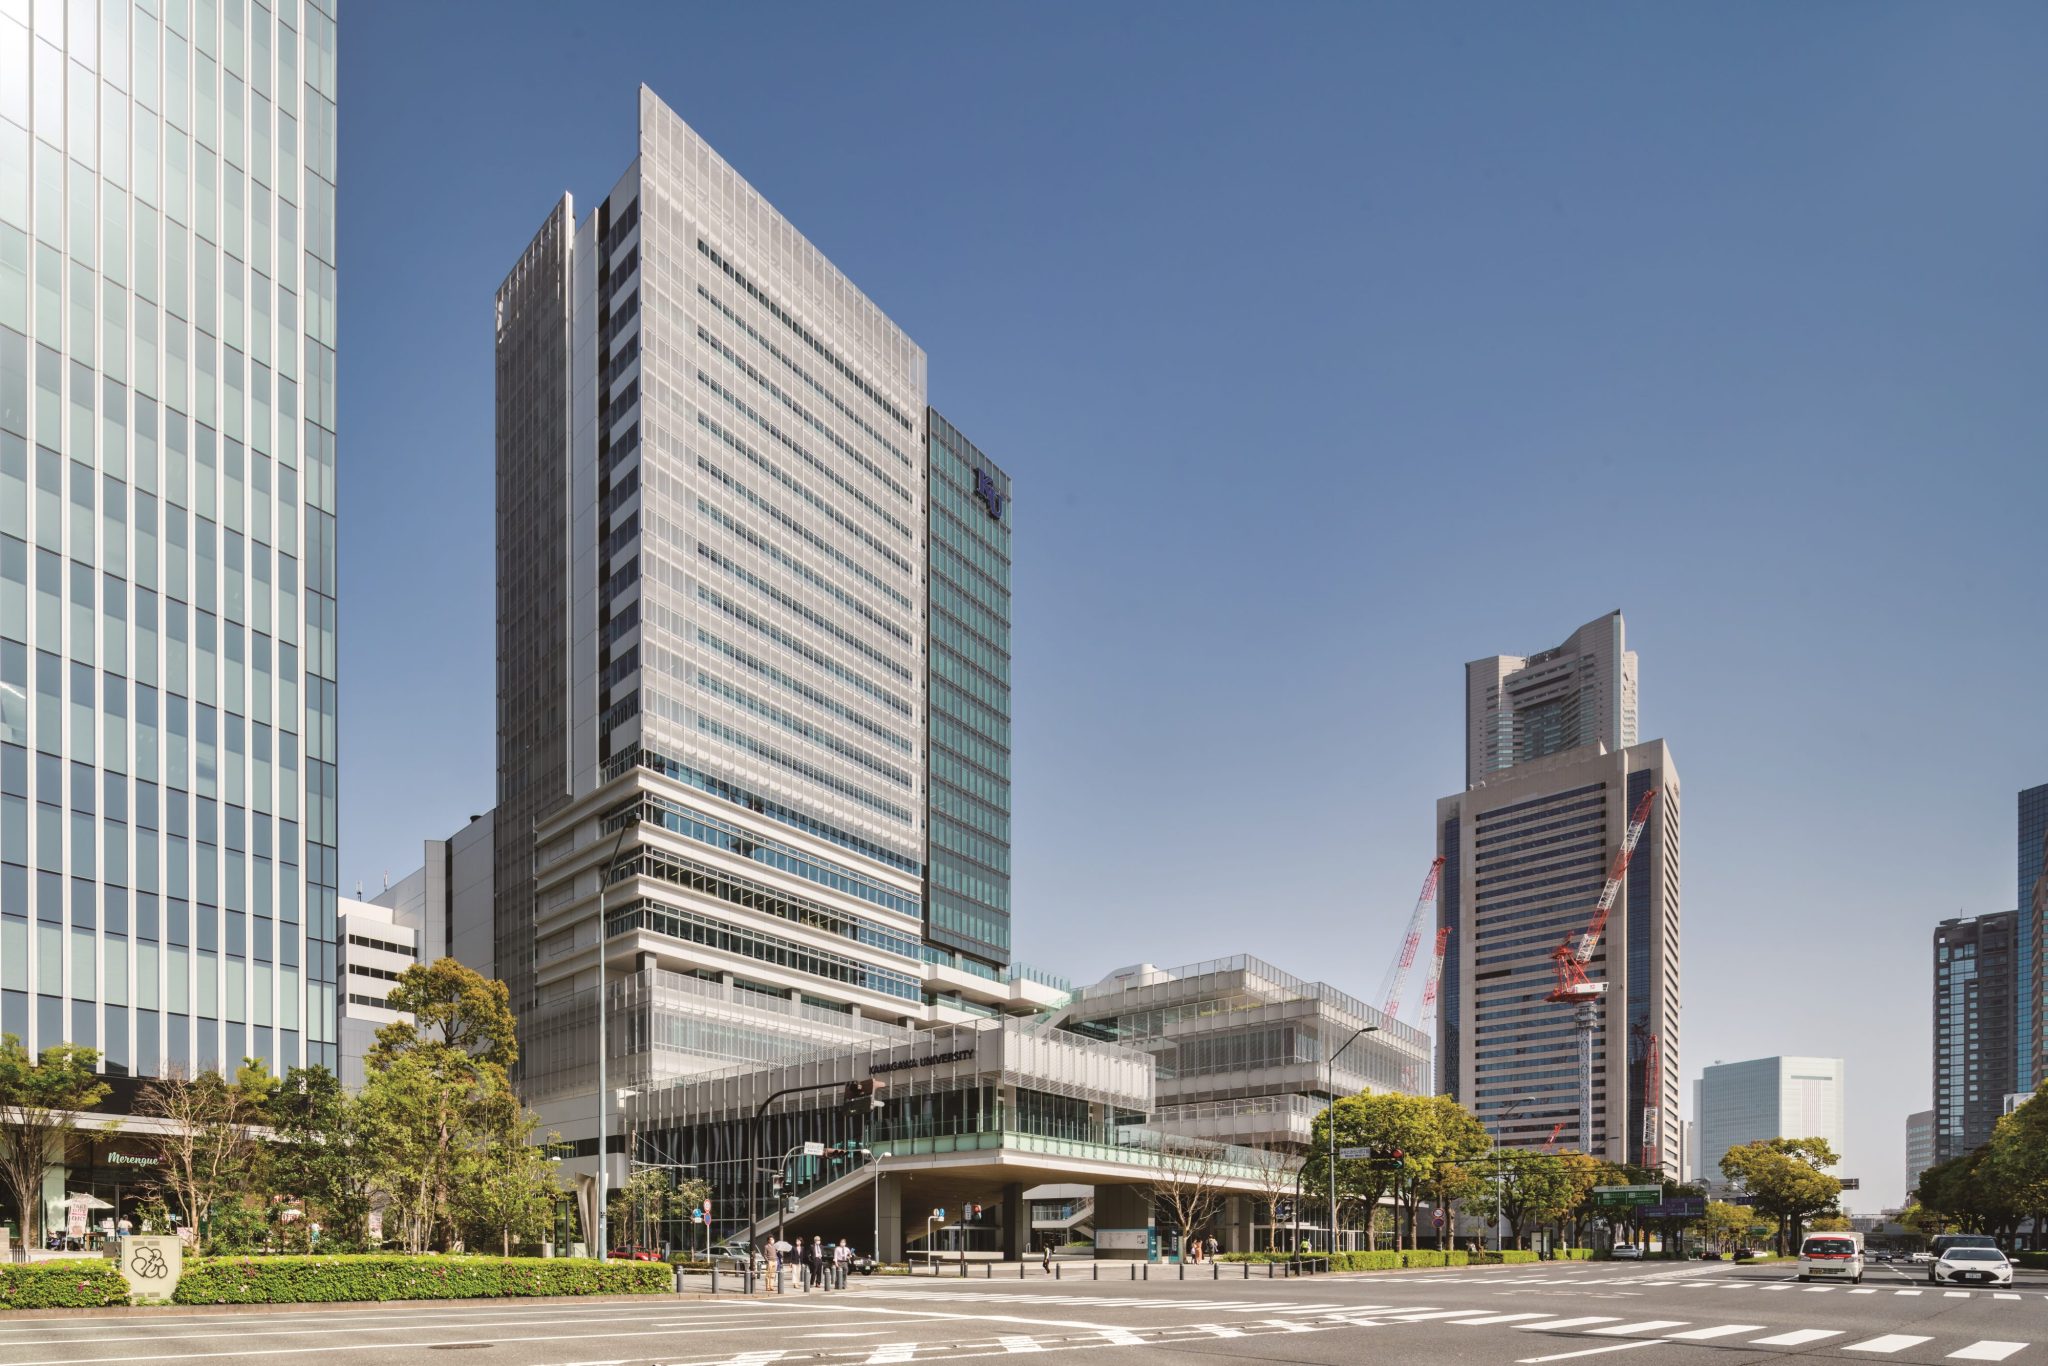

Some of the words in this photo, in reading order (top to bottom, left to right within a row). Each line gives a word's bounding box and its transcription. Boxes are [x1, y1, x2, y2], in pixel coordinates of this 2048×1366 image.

[869, 1059, 917, 1075] KANAGAWA
[920, 1049, 974, 1067] UNIVERSITY
[107, 1151, 159, 1167] Merengue
